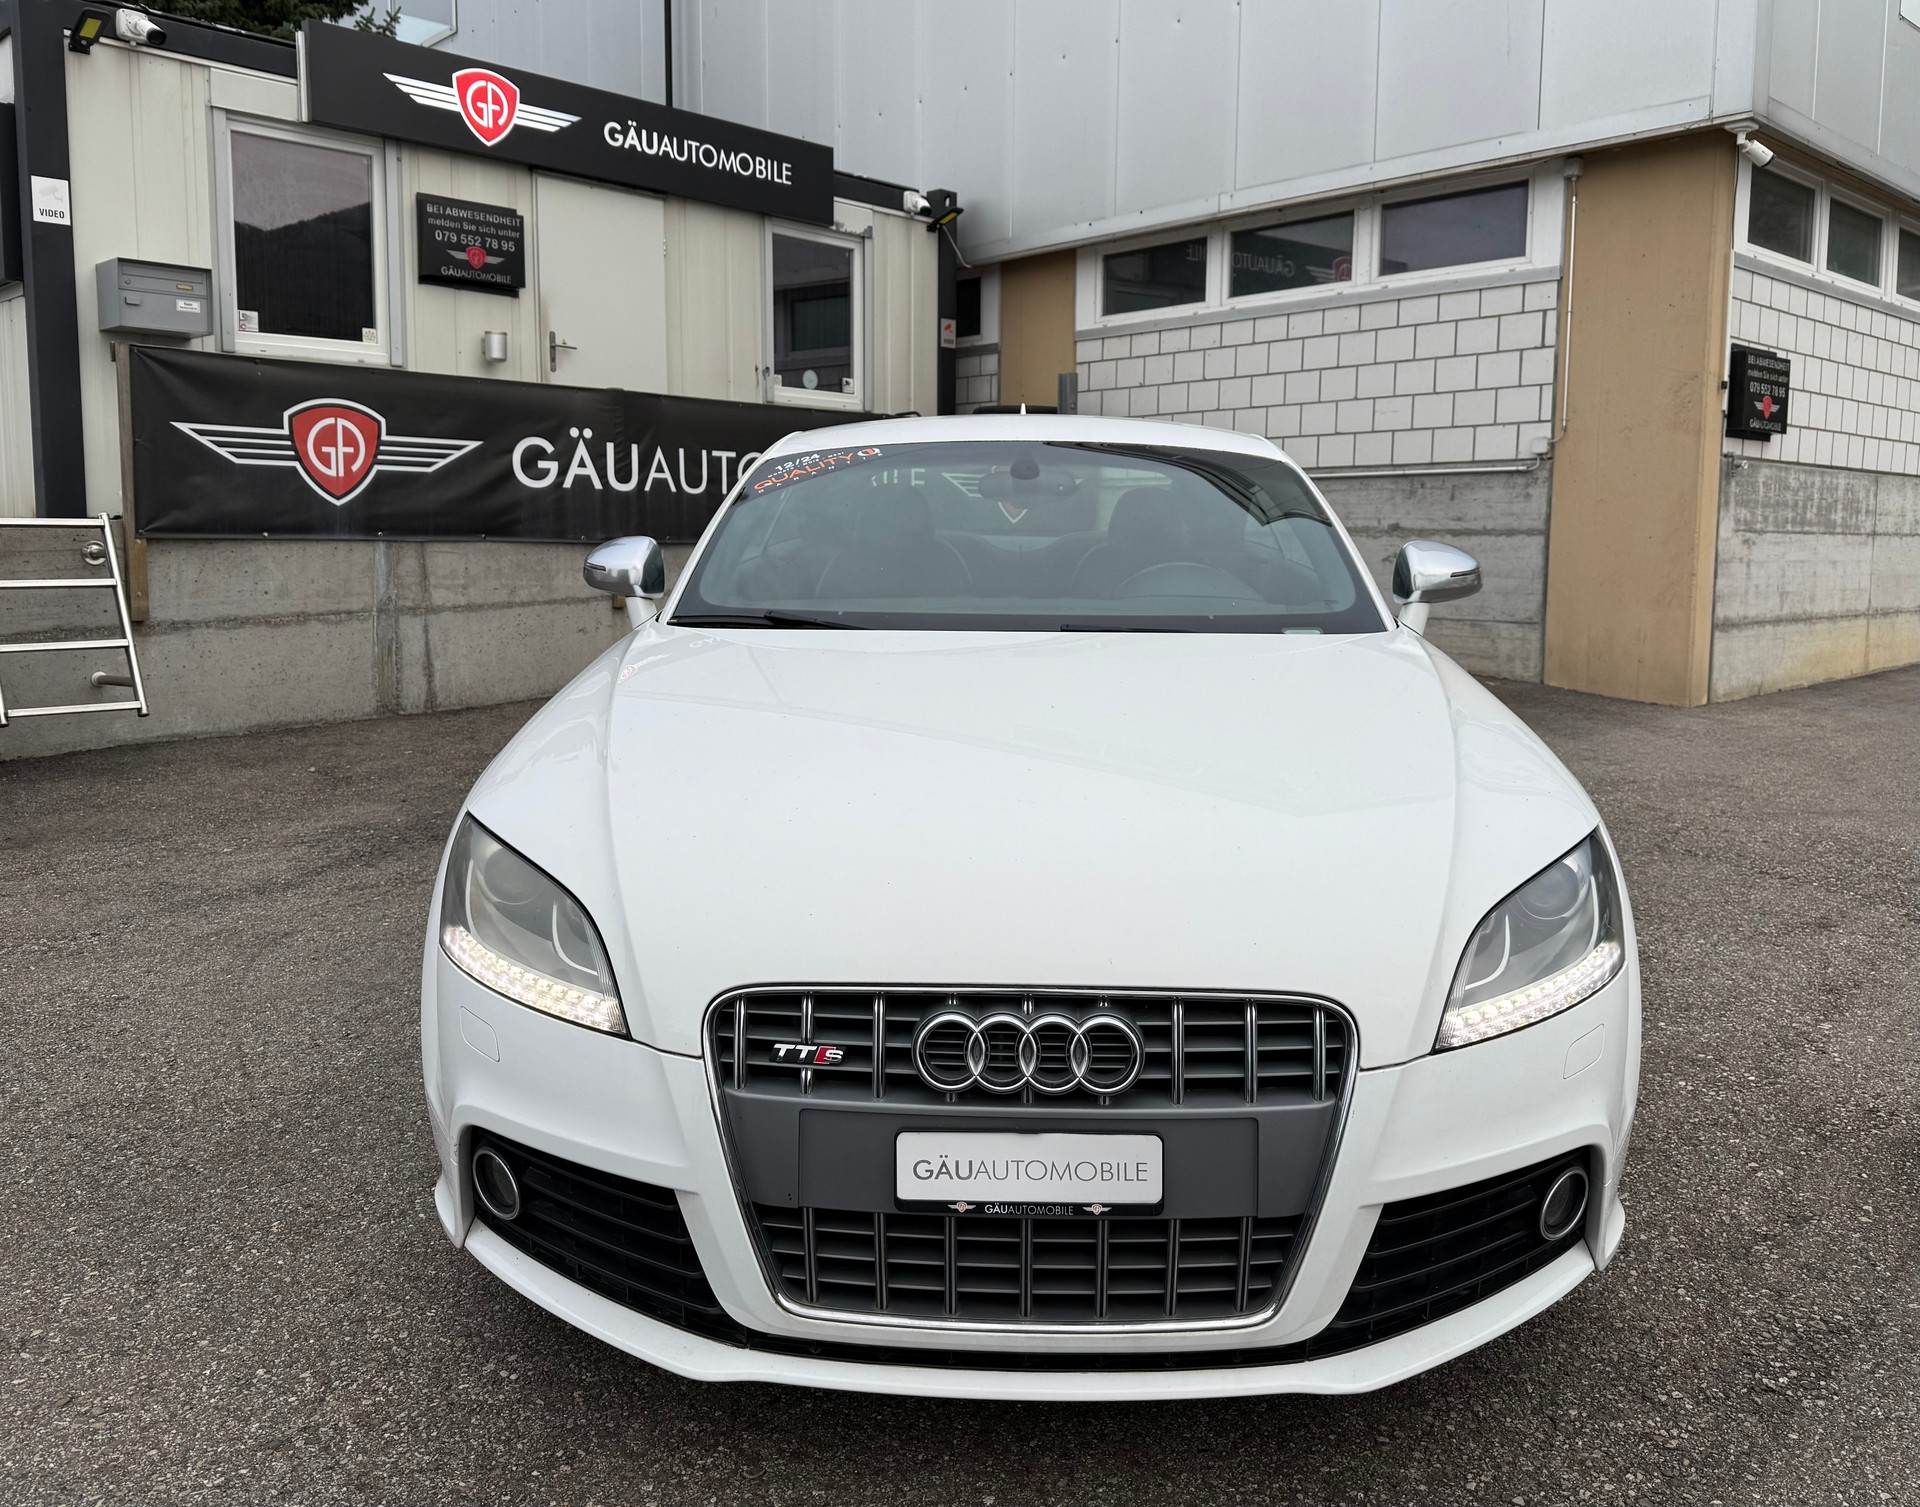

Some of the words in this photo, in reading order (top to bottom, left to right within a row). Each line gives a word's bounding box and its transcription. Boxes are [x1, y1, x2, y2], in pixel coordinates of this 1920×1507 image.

[603, 120, 793, 185] GÄUAUTOMOBILE
[38, 207, 65, 219] VIDEO
[426, 203, 443, 214] BEI
[445, 206, 522, 227] ABWESENDHEIT
[428, 217, 461, 229] melden
[462, 222, 477, 232] Sie
[478, 224, 497, 235] sich
[498, 228, 521, 239] unter
[435, 230, 457, 243] 079
[460, 234, 482, 247] 552
[484, 237, 499, 250] 78
[501, 240, 516, 252] 95
[441, 265, 512, 284] GÄUAUTOMOBILE
[1750, 381, 1760, 394] 079
[1761, 383, 1771, 396] 552
[1772, 385, 1778, 397] 78
[1779, 386, 1786, 398] 95
[754, 452, 853, 490] QUALITY
[775, 453, 820, 471] 12/24
[773, 1043, 844, 1064] TTS
[912, 1154, 1148, 1182] GÄUAUTOMOBILE
[984, 1202, 1074, 1216] GÄUAUTOMOBILE
